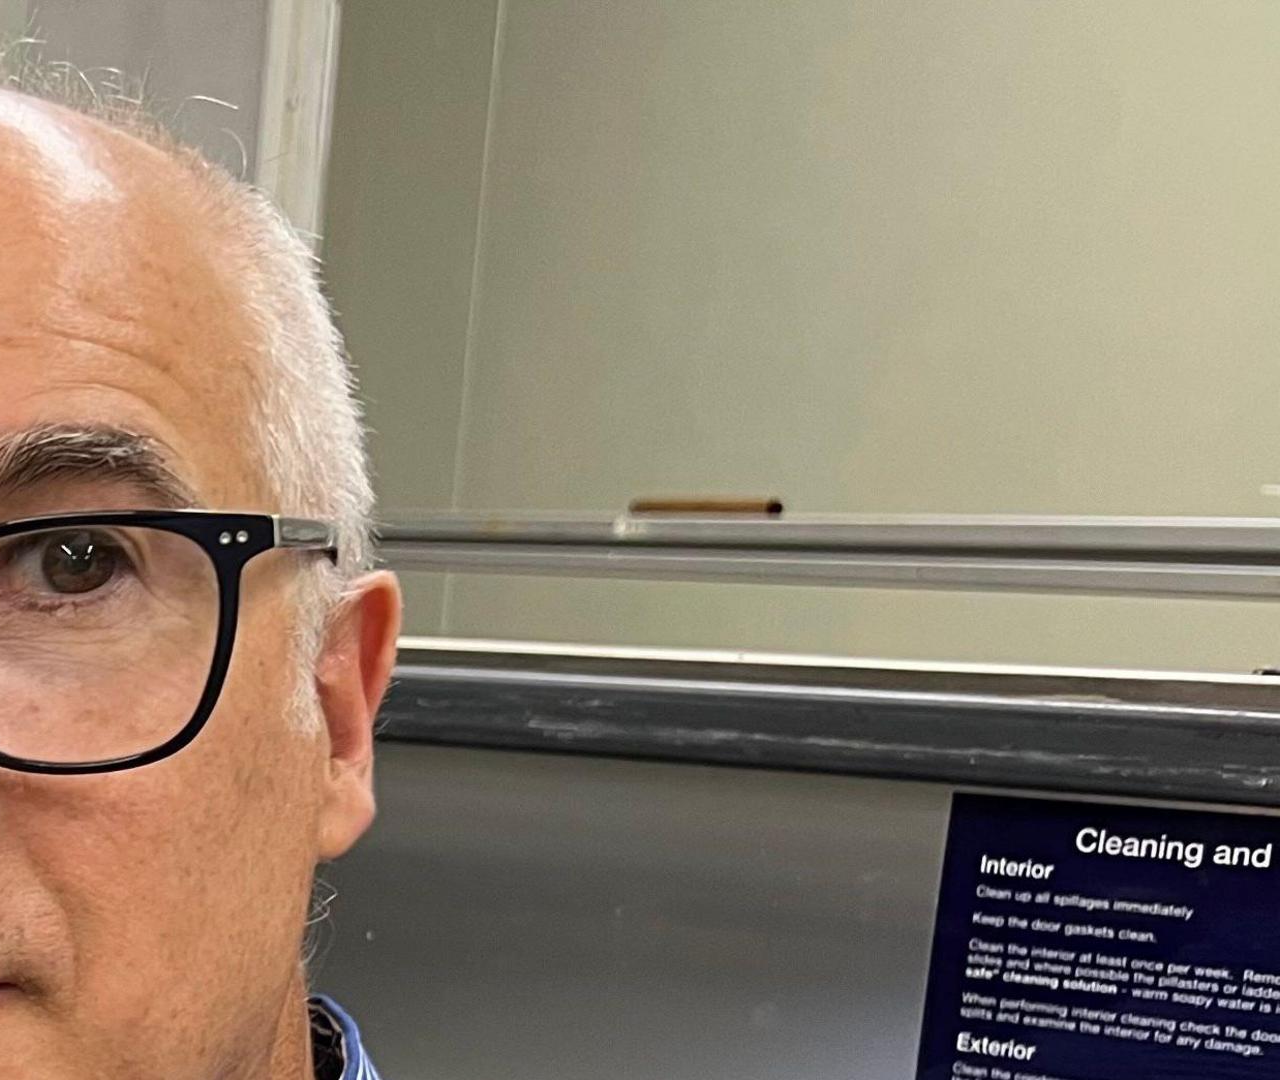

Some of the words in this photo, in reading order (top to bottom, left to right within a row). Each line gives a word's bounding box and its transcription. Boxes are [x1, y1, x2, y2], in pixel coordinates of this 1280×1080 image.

[1075, 827, 1204, 869] Cleaning
[1212, 843, 1273, 868] and
[980, 854, 1055, 879] Interior
[976, 884, 1012, 899] Clean
[1014, 892, 1032, 903] up
[1034, 892, 1051, 903] all
[1112, 901, 1194, 921] immediately
[972, 912, 1005, 928] Keep
[1007, 916, 1029, 929] the
[1031, 919, 1061, 932] door
[1064, 924, 1115, 939] gaskets
[1118, 929, 1156, 942] clean.
[956, 1031, 1036, 1061] Exterior
